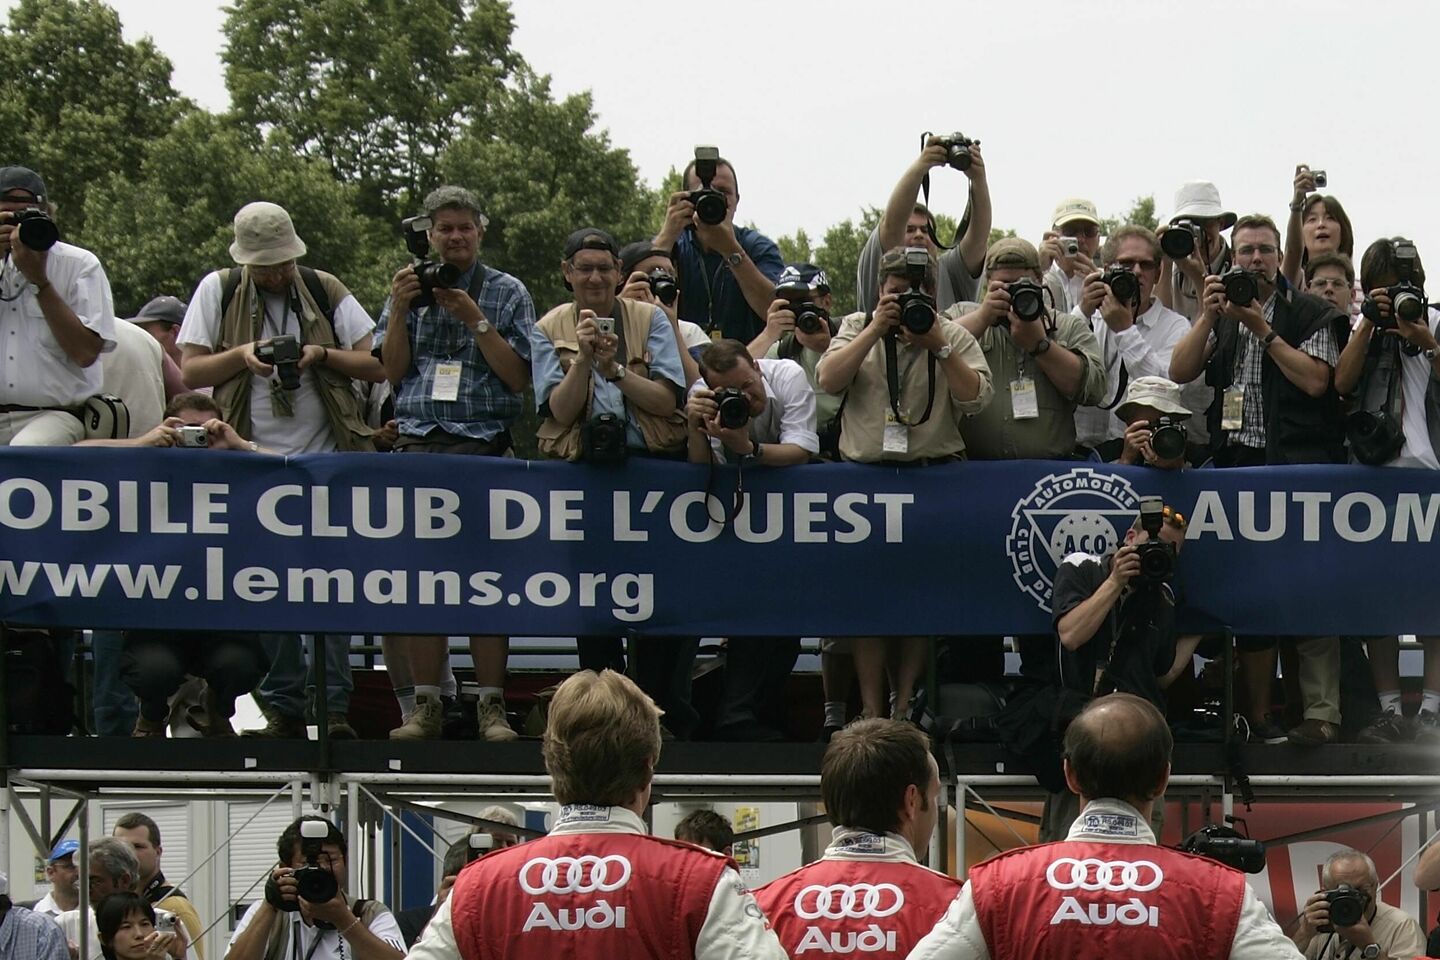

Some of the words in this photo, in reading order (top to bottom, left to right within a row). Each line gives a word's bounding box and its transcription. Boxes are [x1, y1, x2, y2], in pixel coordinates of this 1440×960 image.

[1035, 478, 1135, 508] AUTOMOBILE
[256, 484, 462, 539] CLUB
[489, 488, 585, 541] DE
[612, 488, 915, 544] L'OUEST
[1017, 528, 1034, 574] CLUB
[523, 899, 626, 932] Audi
[1050, 897, 1159, 928] Audi
[795, 924, 896, 954] Audi
